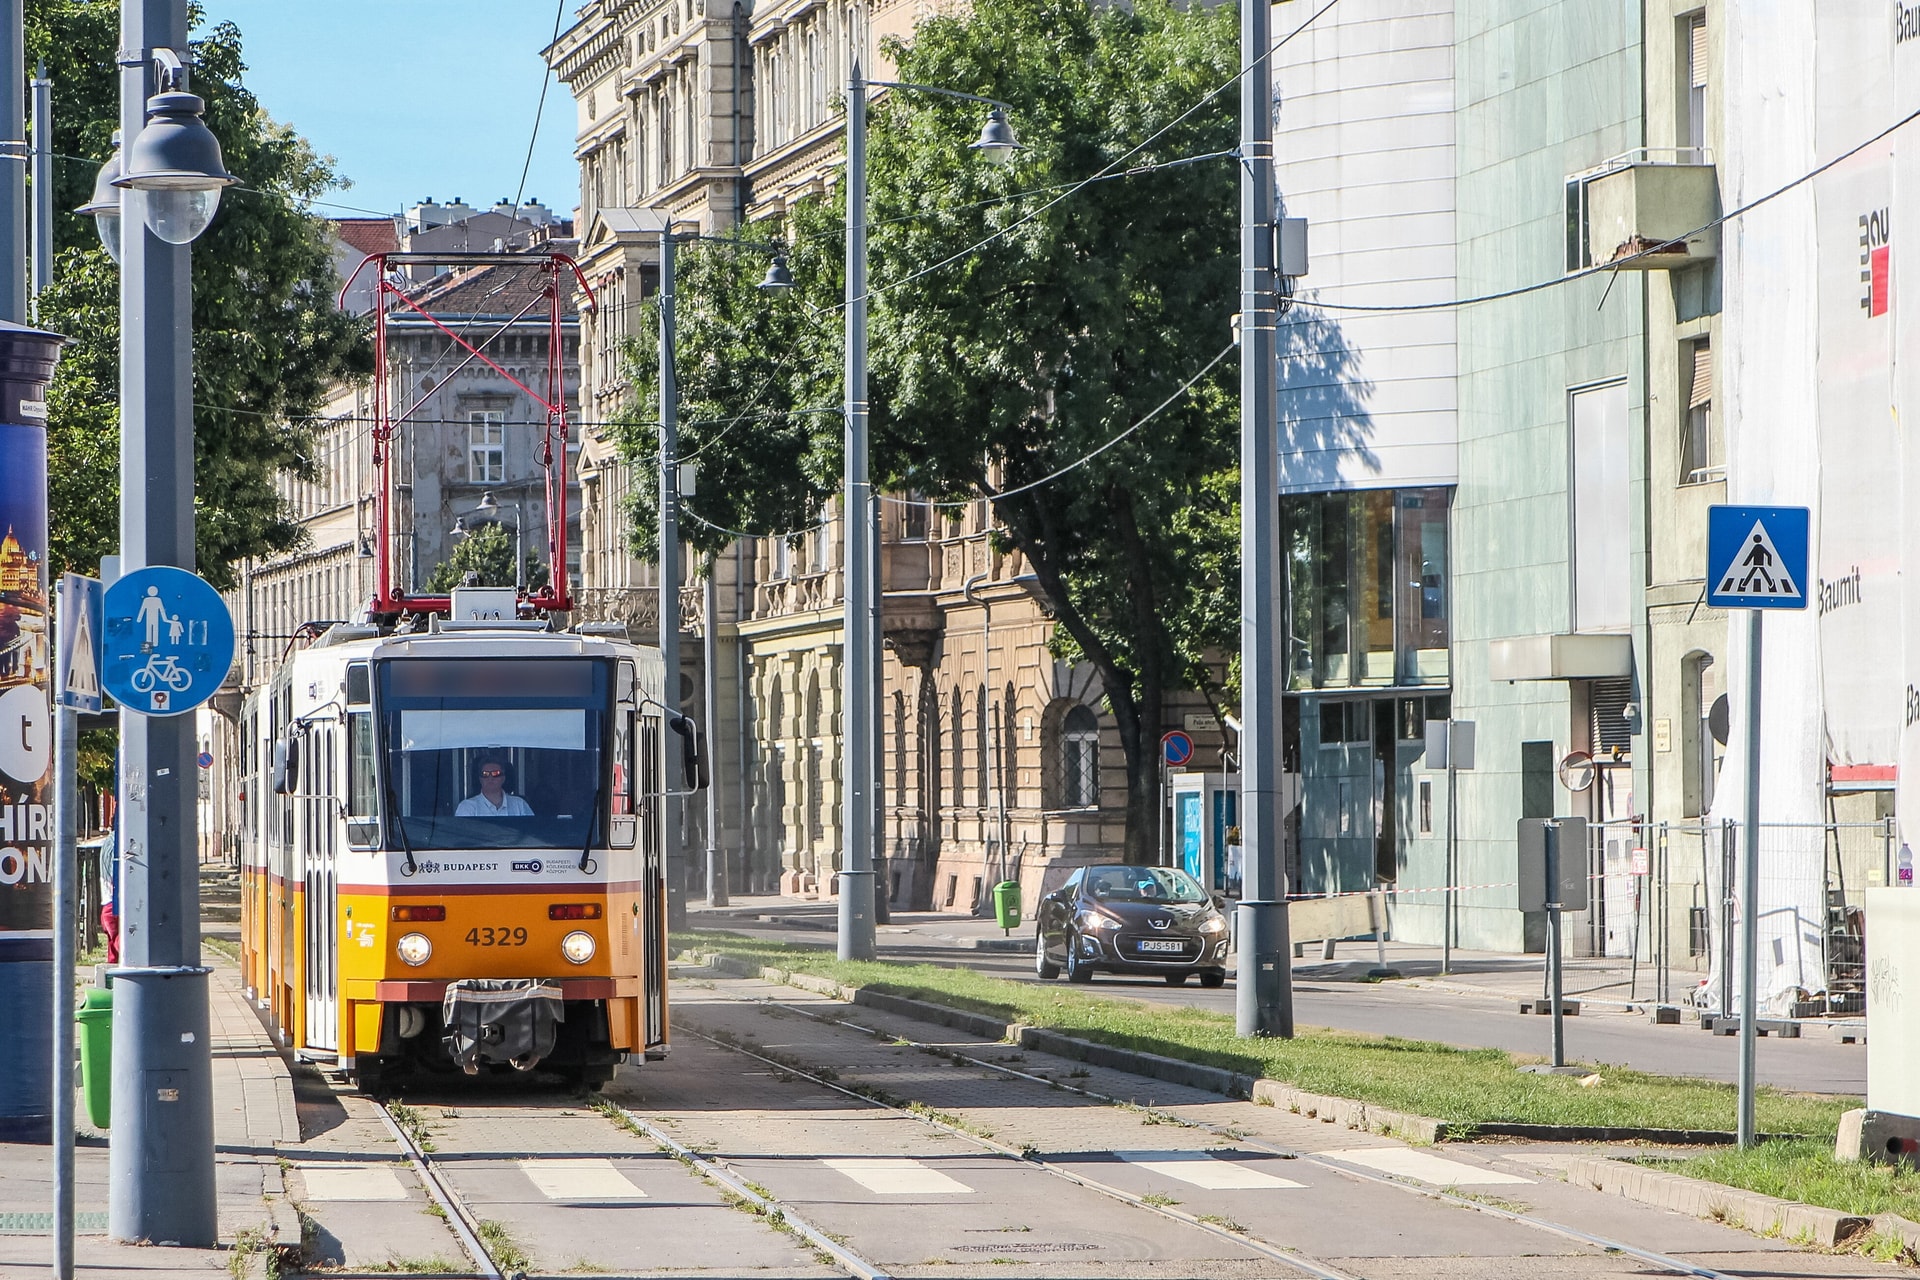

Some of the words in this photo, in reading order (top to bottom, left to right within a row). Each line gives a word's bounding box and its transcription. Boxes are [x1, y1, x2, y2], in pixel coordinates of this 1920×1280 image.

[1896, 0, 1920, 44] Bau
[1819, 565, 1861, 617] Baumit
[21, 714, 33, 752] t
[443, 863, 499, 871] BUDAPEST
[465, 926, 528, 946] 4329
[1143, 941, 1181, 951] PJS-581
